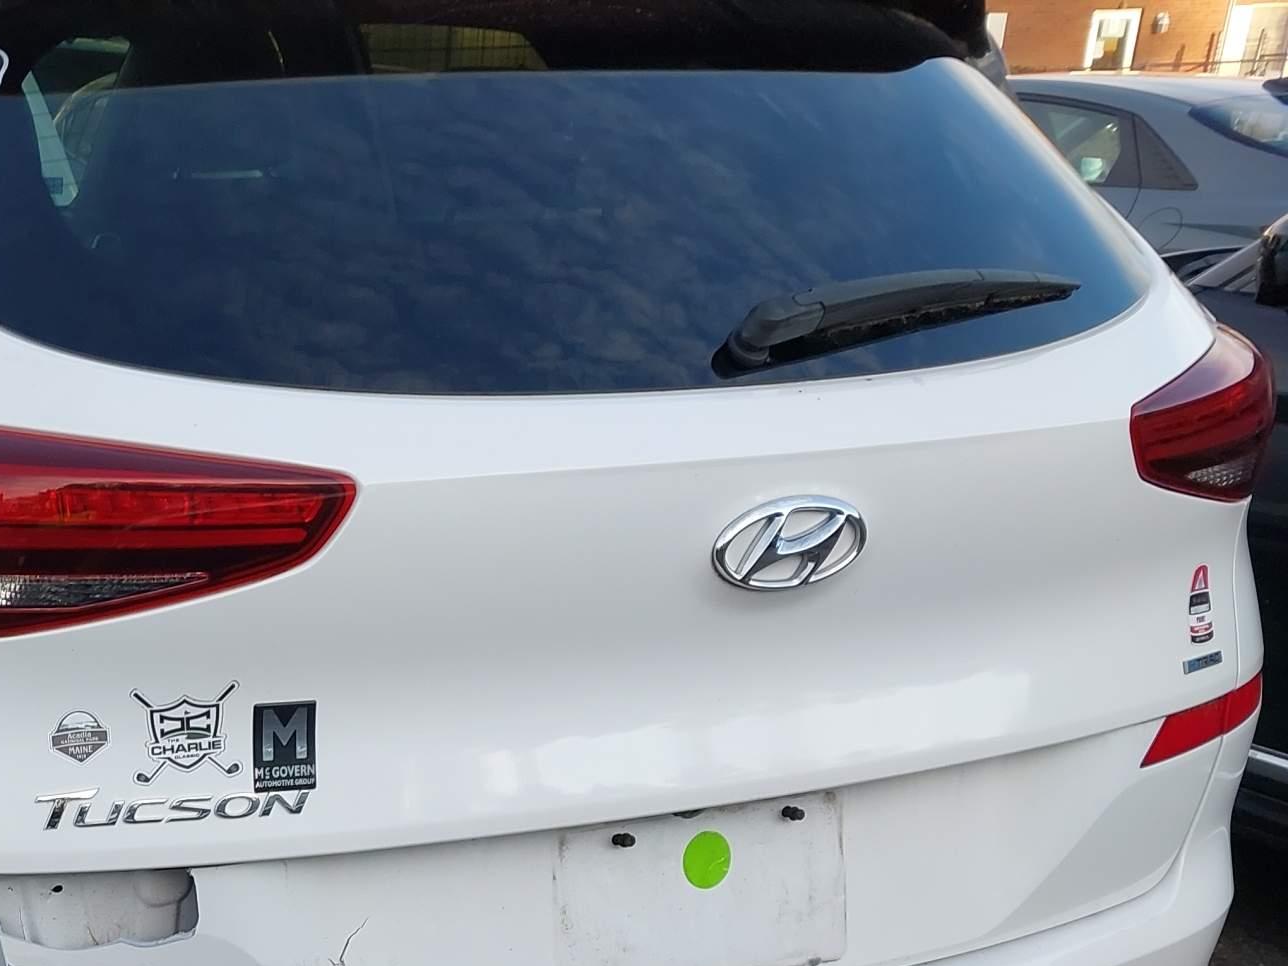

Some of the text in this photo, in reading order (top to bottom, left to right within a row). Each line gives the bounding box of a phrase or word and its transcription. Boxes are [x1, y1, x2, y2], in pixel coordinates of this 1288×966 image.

[263, 706, 307, 761] M
[69, 745, 93, 755] MAINE
[151, 739, 223, 756] CHARLIE
[255, 777, 315, 789] AUTOMOTIVE GROUP
[35, 787, 311, 831] TUCSON
